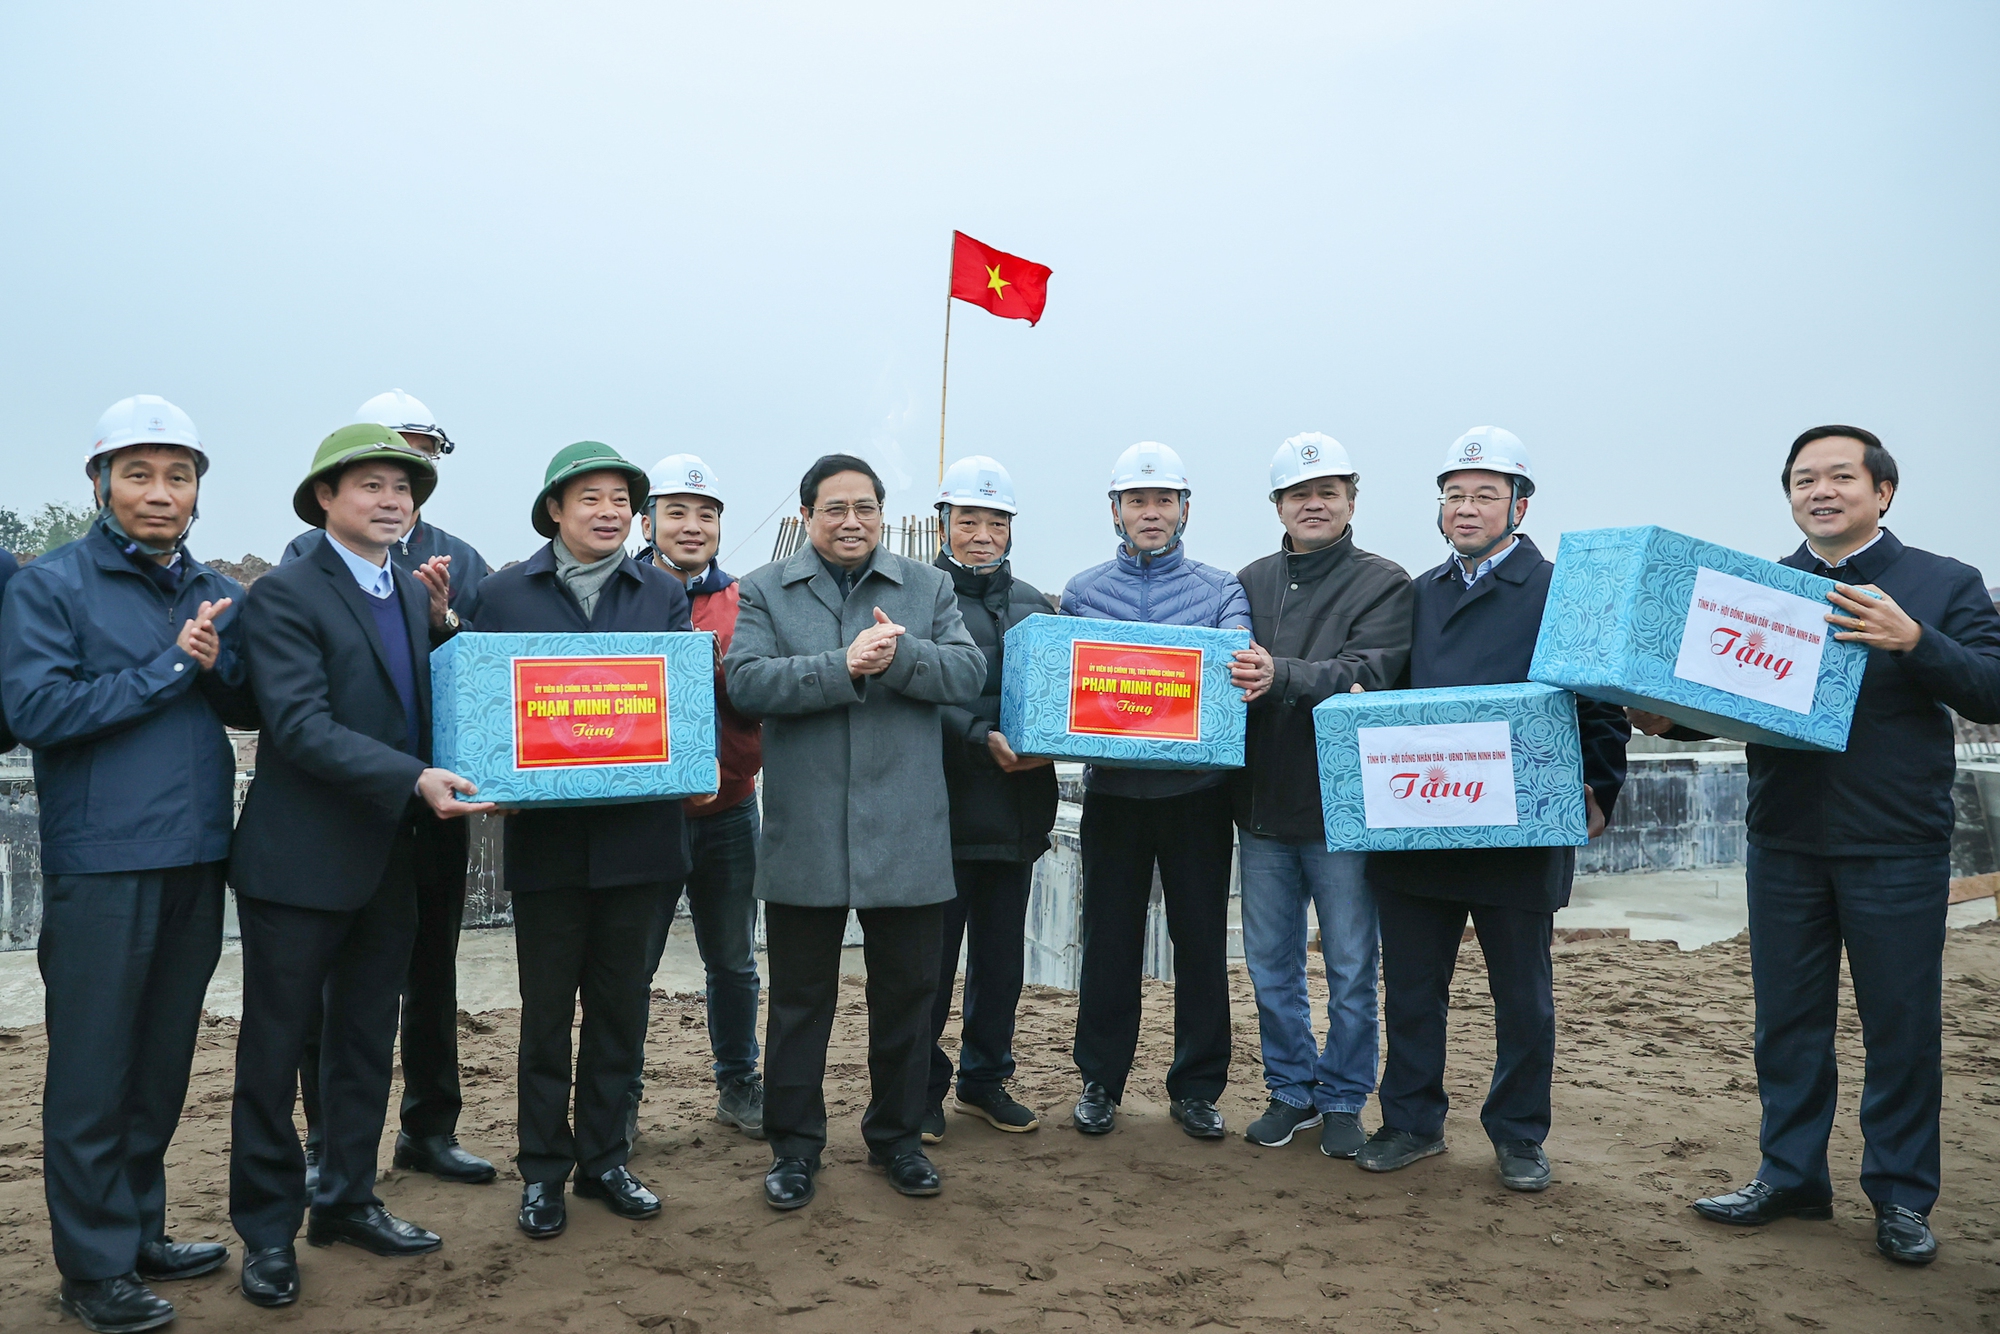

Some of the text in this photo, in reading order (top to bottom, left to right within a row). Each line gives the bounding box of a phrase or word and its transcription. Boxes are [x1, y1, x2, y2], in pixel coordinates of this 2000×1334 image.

[1744, 613, 1758, 625] NHÂN
[1758, 616, 1769, 628] DÂN
[1771, 621, 1785, 633] UBND
[1796, 629, 1808, 641] NINH
[1710, 627, 1793, 680] Tặng
[1081, 677, 1191, 698] PHẠM MINH CHÍNH
[527, 695, 657, 720] PHẠM MINH CHÍNH
[1116, 699, 1153, 715] Tặng
[571, 723, 615, 739] Tặng
[1417, 752, 1431, 762] NHÂN
[1433, 752, 1444, 762] DÂN
[1449, 752, 1463, 761] UBND
[1478, 751, 1491, 760] NINH
[1389, 772, 1487, 803] Tặng
